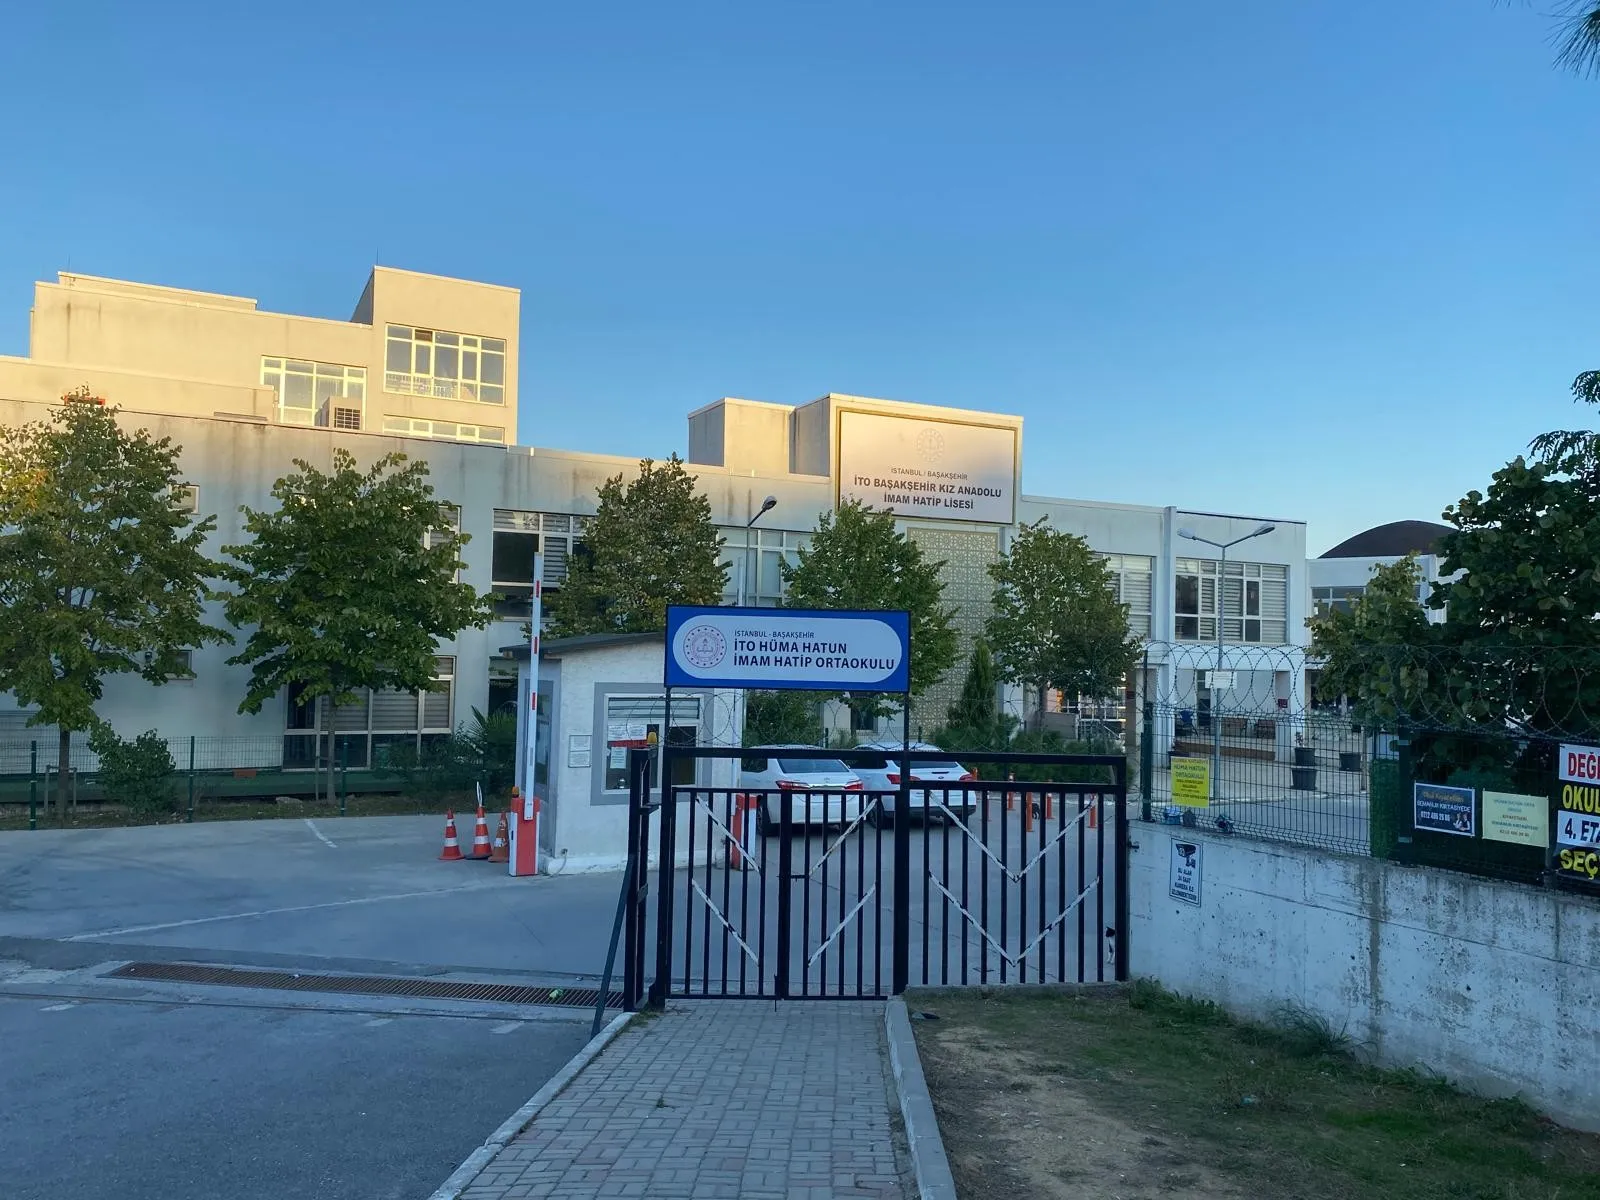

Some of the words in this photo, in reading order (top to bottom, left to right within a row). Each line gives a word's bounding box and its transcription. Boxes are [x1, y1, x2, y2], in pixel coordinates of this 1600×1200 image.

[927, 470, 968, 481] BAŞAKŞEHİR
[854, 474, 871, 487] İTO
[874, 477, 936, 493] BAŞAKŞEHİR
[938, 485, 955, 494] KIZ
[957, 486, 1002, 498] ANADOLU
[884, 491, 910, 505] İMAM
[913, 495, 941, 507] HATİP
[944, 498, 974, 510] LİSESİ
[734, 630, 767, 638] İSTANBUL
[772, 631, 815, 640] BAŞAKŞEHİR
[734, 638, 756, 652] İTO
[759, 639, 799, 653] HÜMA
[803, 642, 847, 654] HATUN
[733, 655, 771, 667] İMAM
[775, 655, 812, 668] HATİP
[815, 658, 895, 670] ORTAOKULU
[1568, 751, 1600, 780] DEĞ
[1565, 818, 1576, 840] 4.
